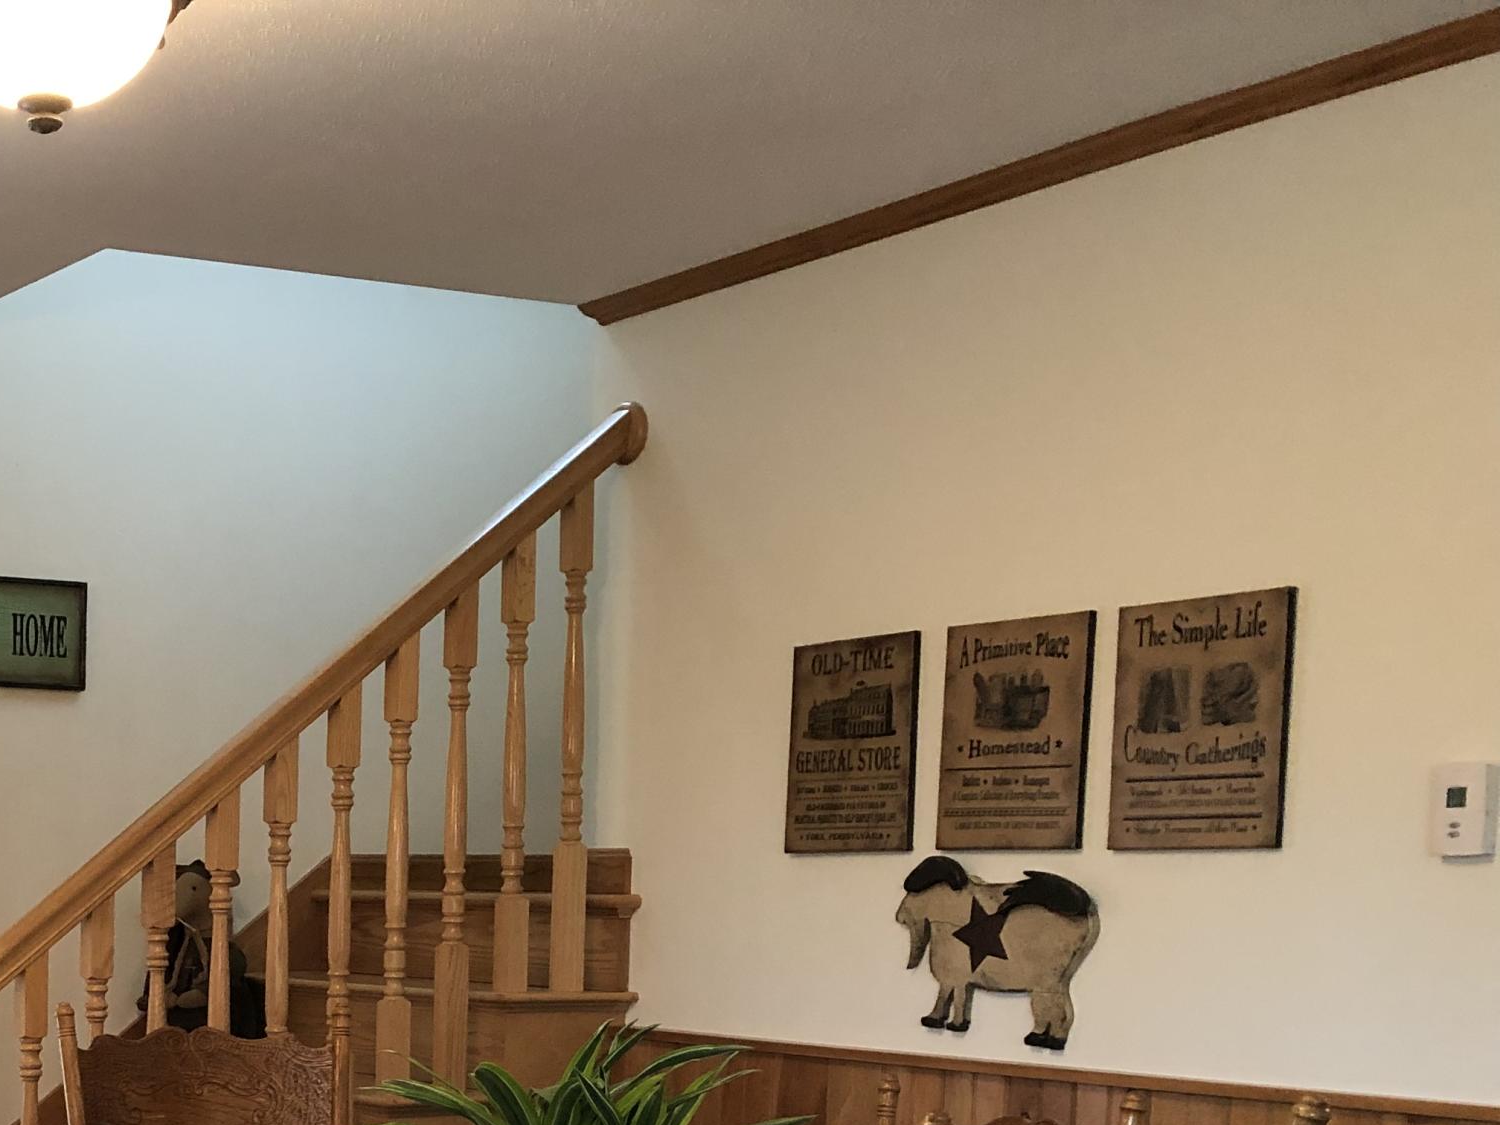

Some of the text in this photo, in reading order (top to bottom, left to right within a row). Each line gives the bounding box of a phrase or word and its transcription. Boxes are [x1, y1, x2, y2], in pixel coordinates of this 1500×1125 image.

[11, 613, 68, 659] HOME
[1134, 601, 1267, 650] The Simple Life
[811, 646, 895, 676] OLD-TIME
[960, 631, 1070, 669] A Primitive Place
[796, 746, 901, 774] GENERAL STORE
[968, 735, 1051, 759] Homestead
[1124, 724, 1267, 772] Country Gatherings
